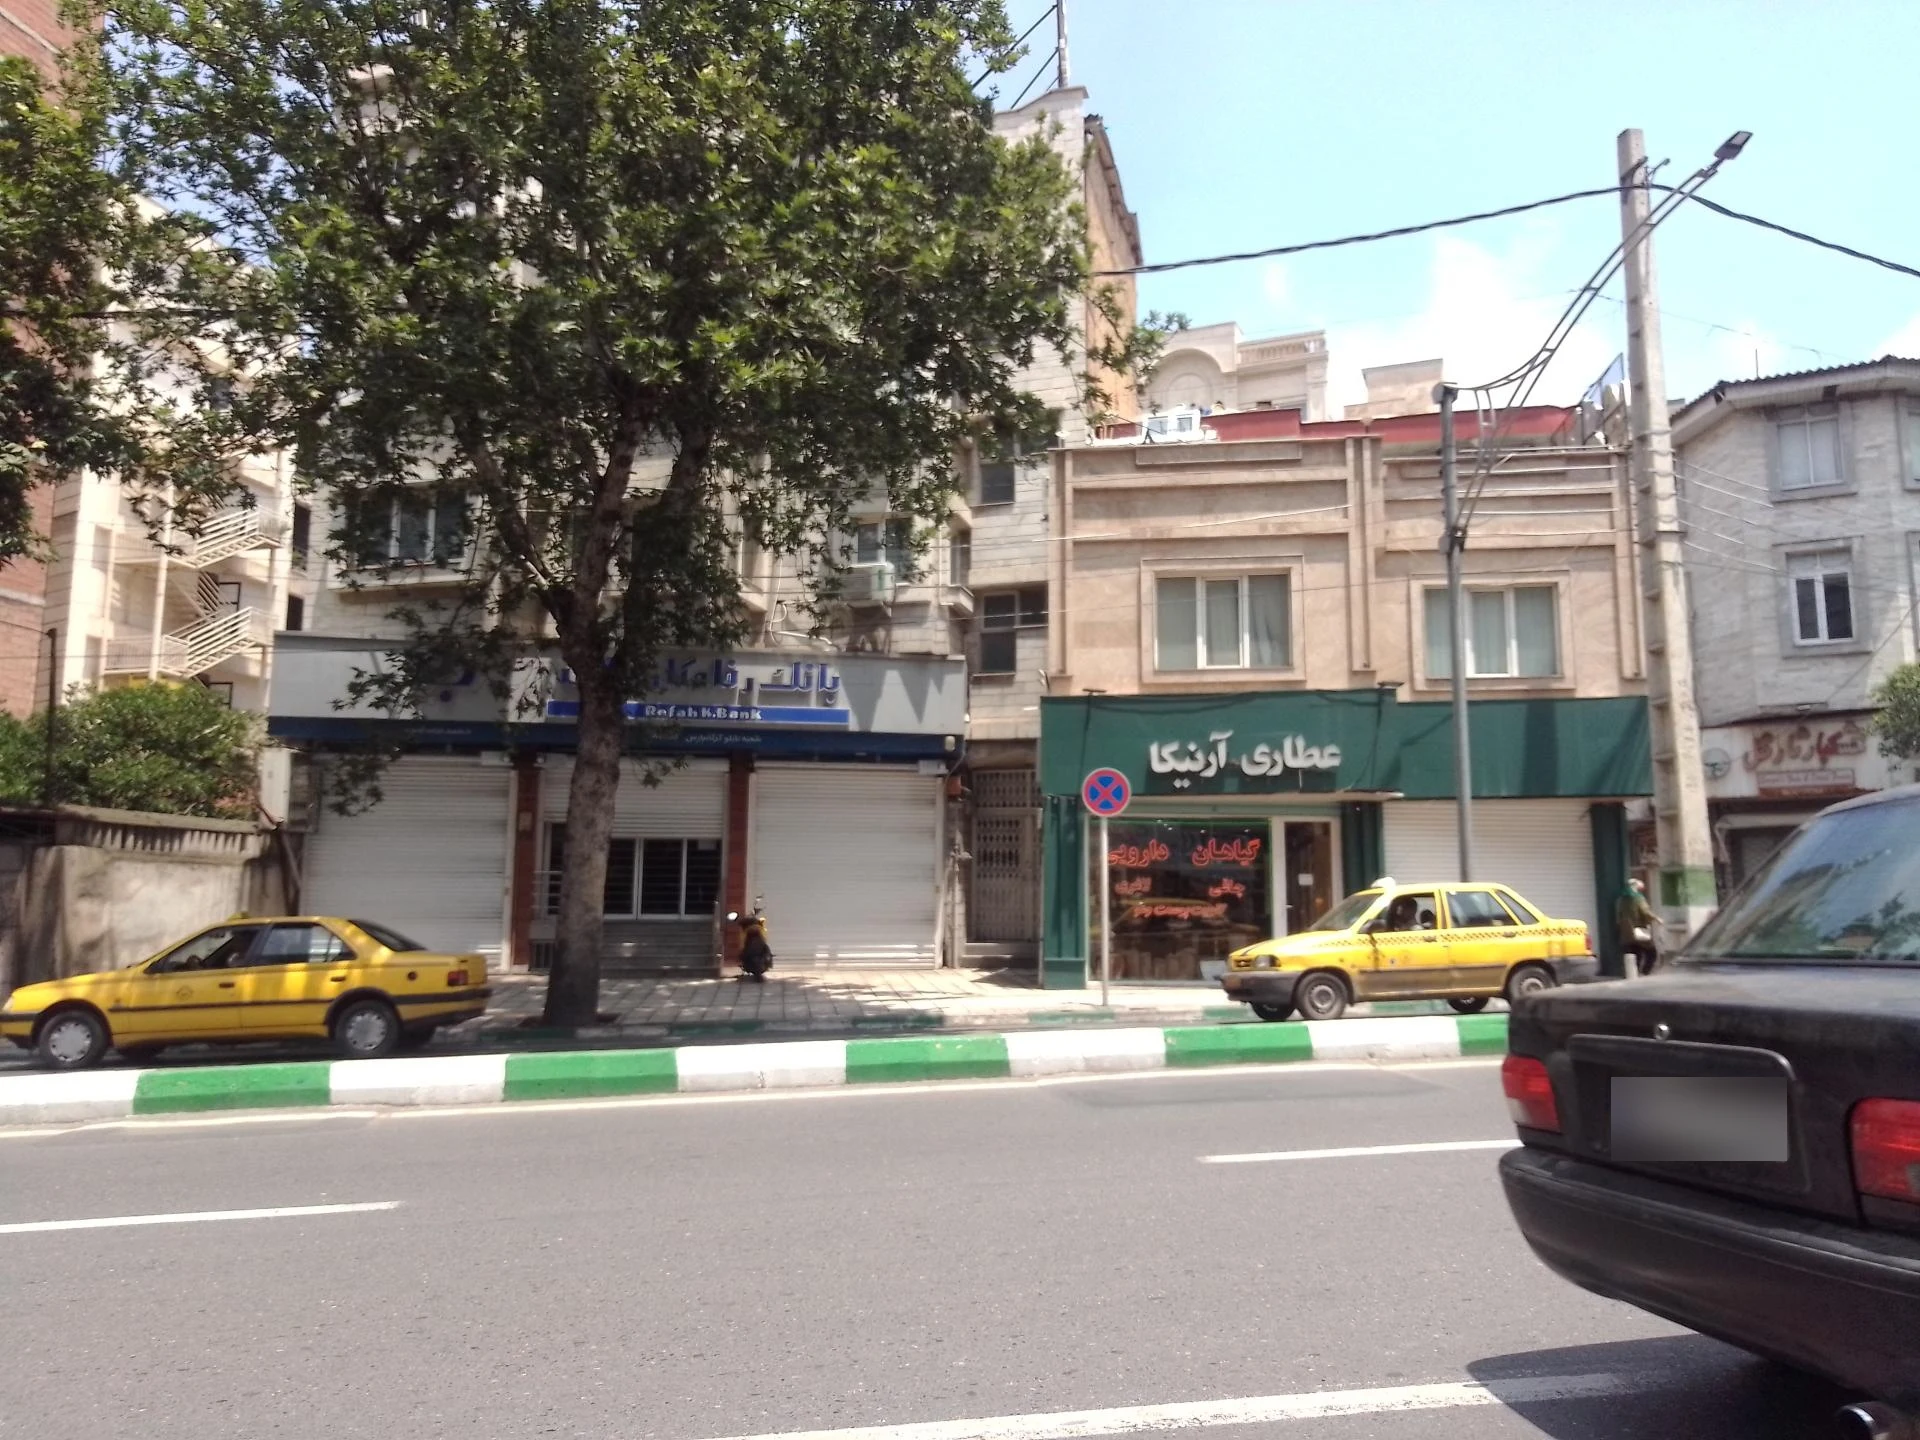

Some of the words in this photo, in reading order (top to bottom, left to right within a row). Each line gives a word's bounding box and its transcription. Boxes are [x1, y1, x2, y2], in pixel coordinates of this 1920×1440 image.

[759, 662, 841, 707] بانک
[645, 704, 698, 719] Refah
[701, 705, 763, 721] K.Bank
[1150, 730, 1234, 789] آرنیکا
[1241, 734, 1342, 777] عطاری
[1192, 838, 1261, 868] گیاهان
